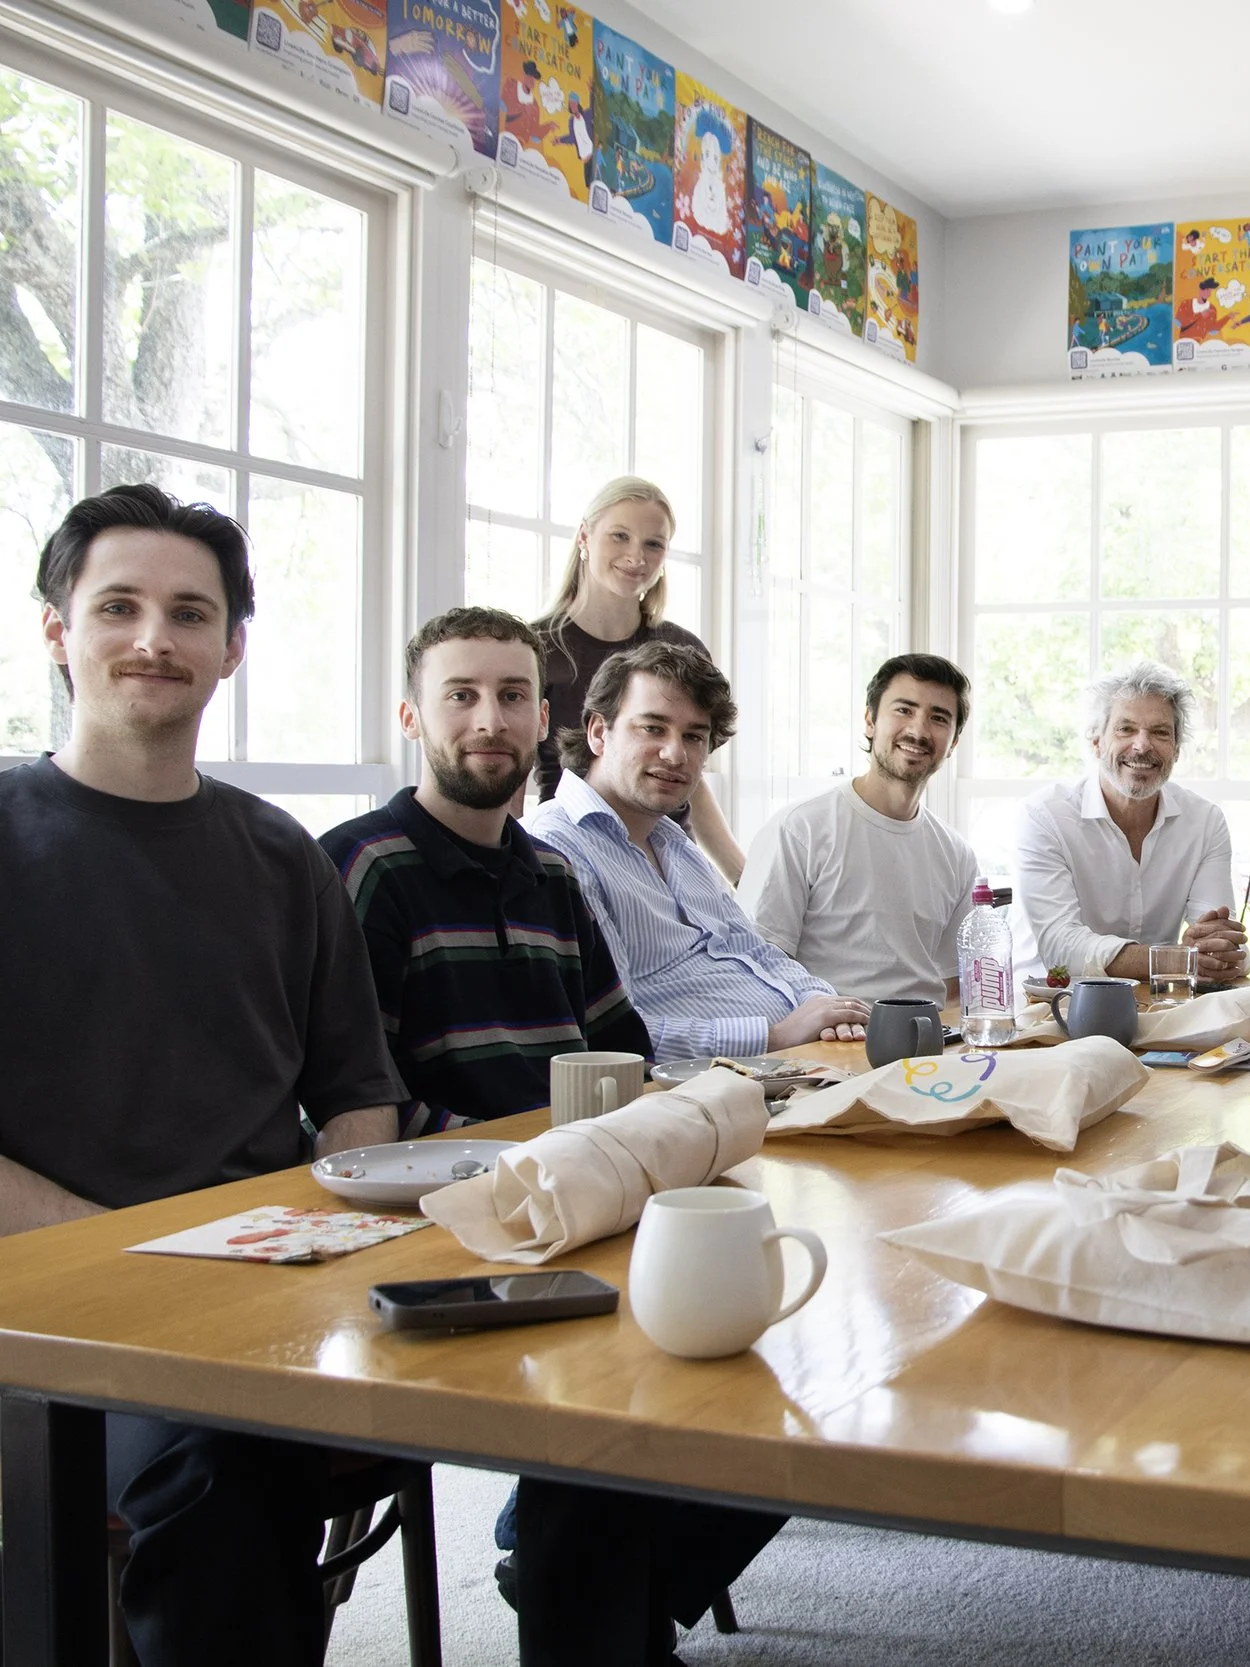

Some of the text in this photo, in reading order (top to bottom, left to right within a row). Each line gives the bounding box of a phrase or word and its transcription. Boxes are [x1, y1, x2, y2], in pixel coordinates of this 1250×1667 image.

[461, 4, 496, 29] BETTER
[513, 20, 570, 60] START THE
[504, 34, 582, 79] CONVERSATION
[602, 66, 629, 93] OWN
[1124, 236, 1162, 254] YOUR
[1080, 250, 1158, 272] OWN PATH
[1192, 250, 1227, 267] START
[980, 957, 1006, 1012] pump
